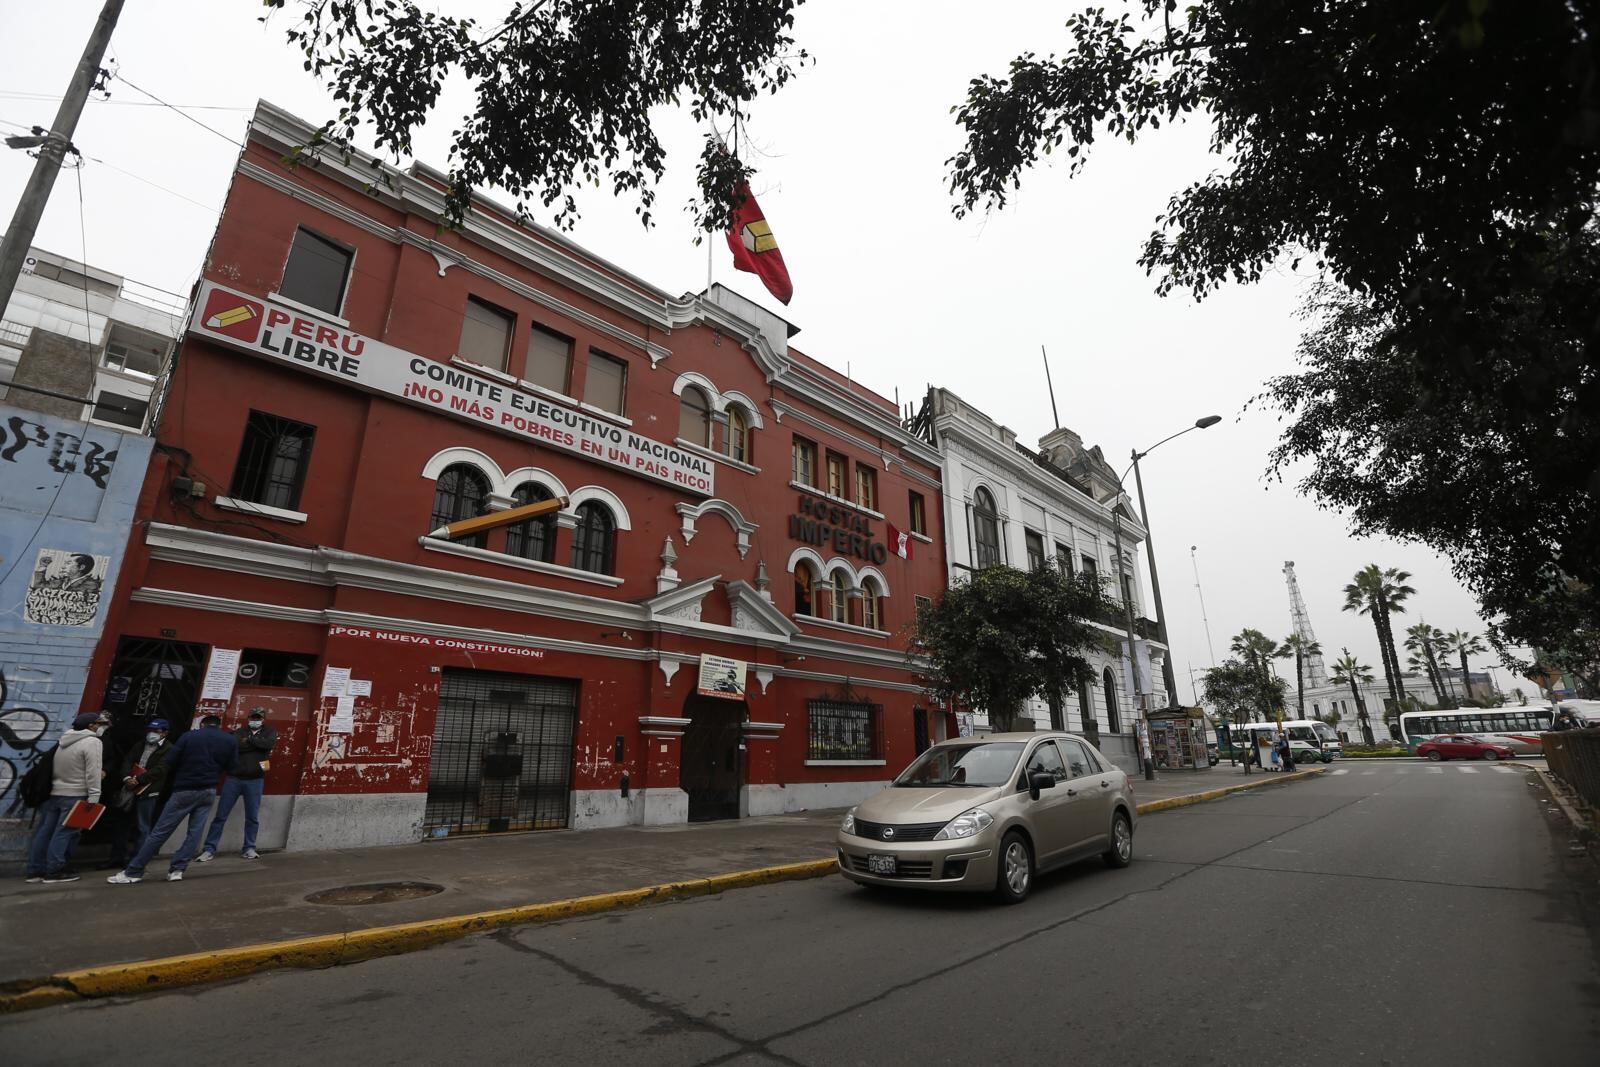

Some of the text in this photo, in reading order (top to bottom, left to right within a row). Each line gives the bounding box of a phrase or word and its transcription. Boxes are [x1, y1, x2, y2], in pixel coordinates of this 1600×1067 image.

[260, 331, 361, 378] LIBRE
[266, 308, 365, 357] PERÚ
[403, 382, 711, 492] ¡NO MÁS POBRES EN UN PAÍS RICO!
[409, 358, 711, 476] COMITE EJECUTIVO NACIONAL
[789, 513, 888, 565] IMPERIO
[799, 494, 875, 537] HOSTAL
[329, 626, 544, 658] ¡POR NUEVA CONSTITUCIÓN!
